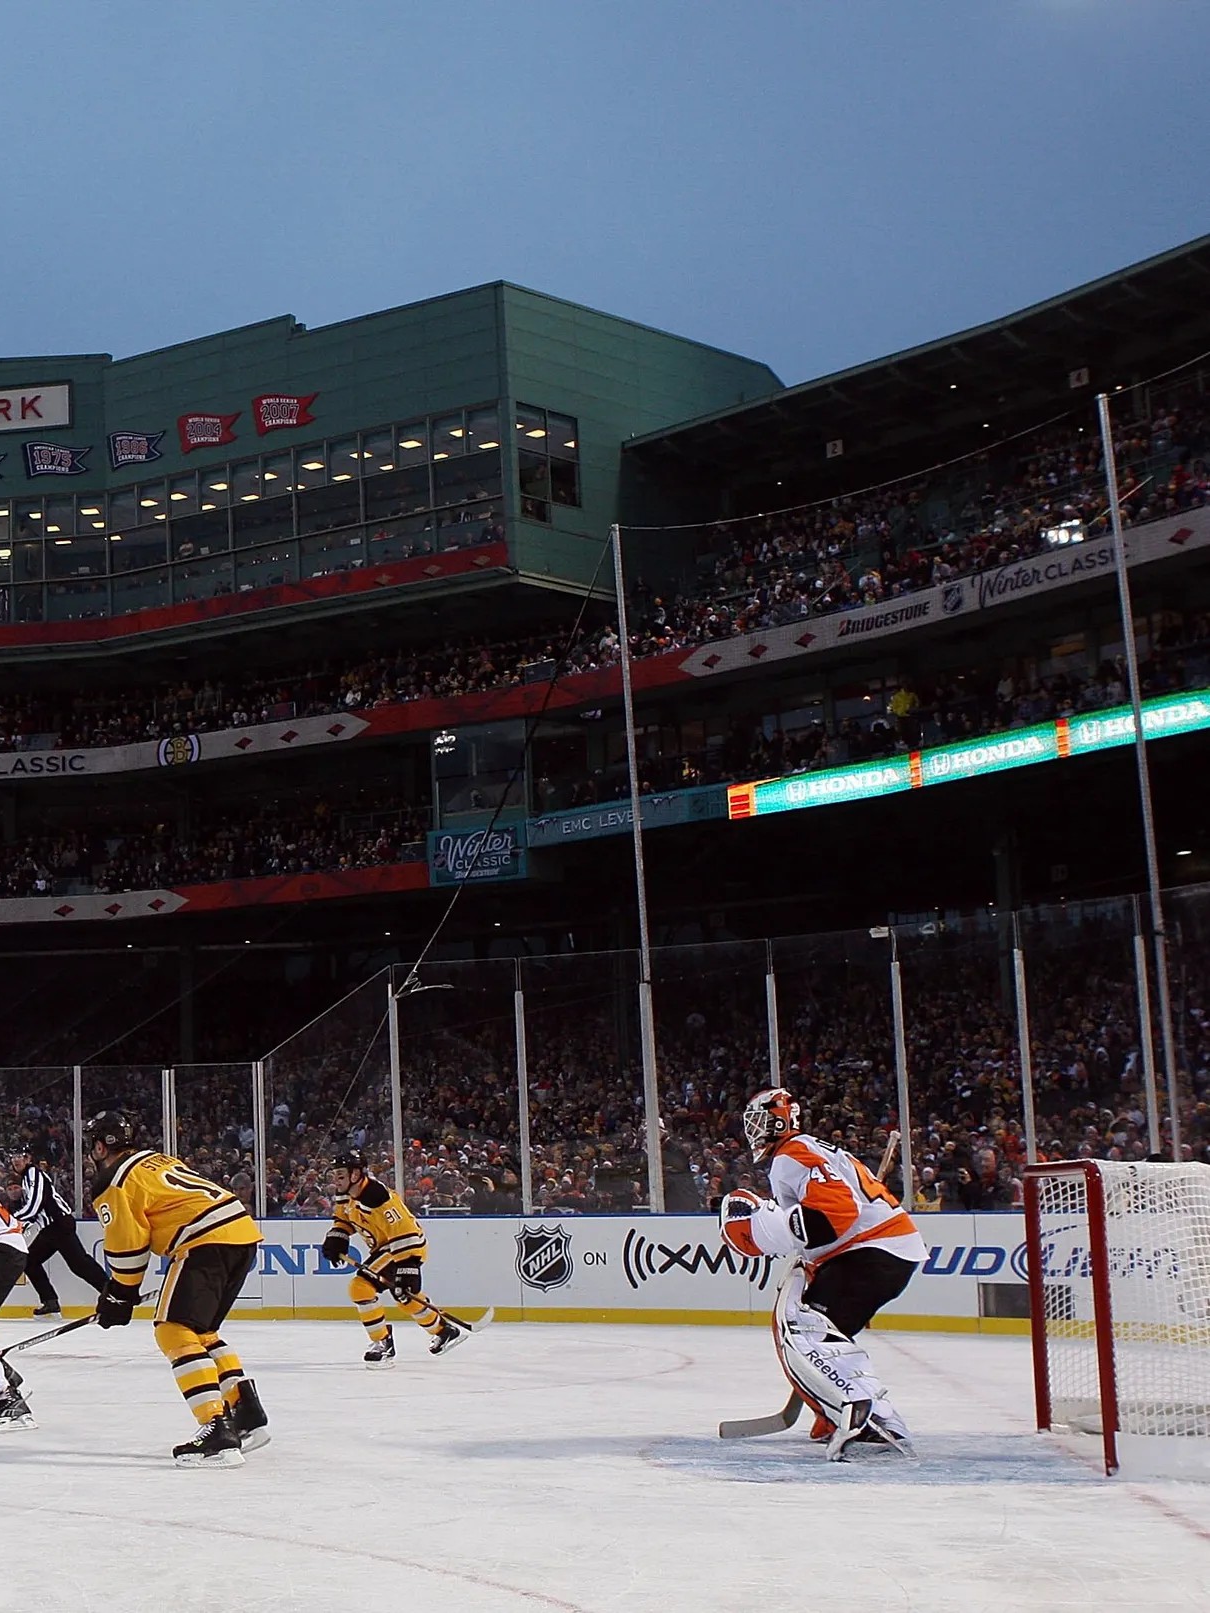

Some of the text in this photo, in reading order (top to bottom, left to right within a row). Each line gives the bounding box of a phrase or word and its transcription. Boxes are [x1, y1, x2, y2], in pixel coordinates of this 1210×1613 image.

[259, 403, 300, 422] 2007
[186, 421, 223, 440] 2004
[264, 417, 297, 428] CHAMPIONS
[115, 440, 148, 456] 1986
[190, 436, 220, 444] CHAMPIONS
[33, 450, 72, 467] 1975
[36, 464, 69, 473] CHAMPIONS
[971, 566, 1042, 609] Winter
[1044, 543, 1129, 580] CLASSI
[838, 601, 931, 636] BRIDGESTONE
[951, 734, 1045, 768] HONDA
[808, 764, 901, 797] HONDA
[562, 818, 592, 834] EMC
[440, 829, 515, 872] Winter
[455, 854, 511, 871] CLASSIC
[384, 1207, 403, 1226] 91
[528, 1243, 562, 1277] NHL
[583, 1252, 607, 1266] ON
[922, 1245, 1007, 1276] UD
[806, 1350, 855, 1396] Reebok
